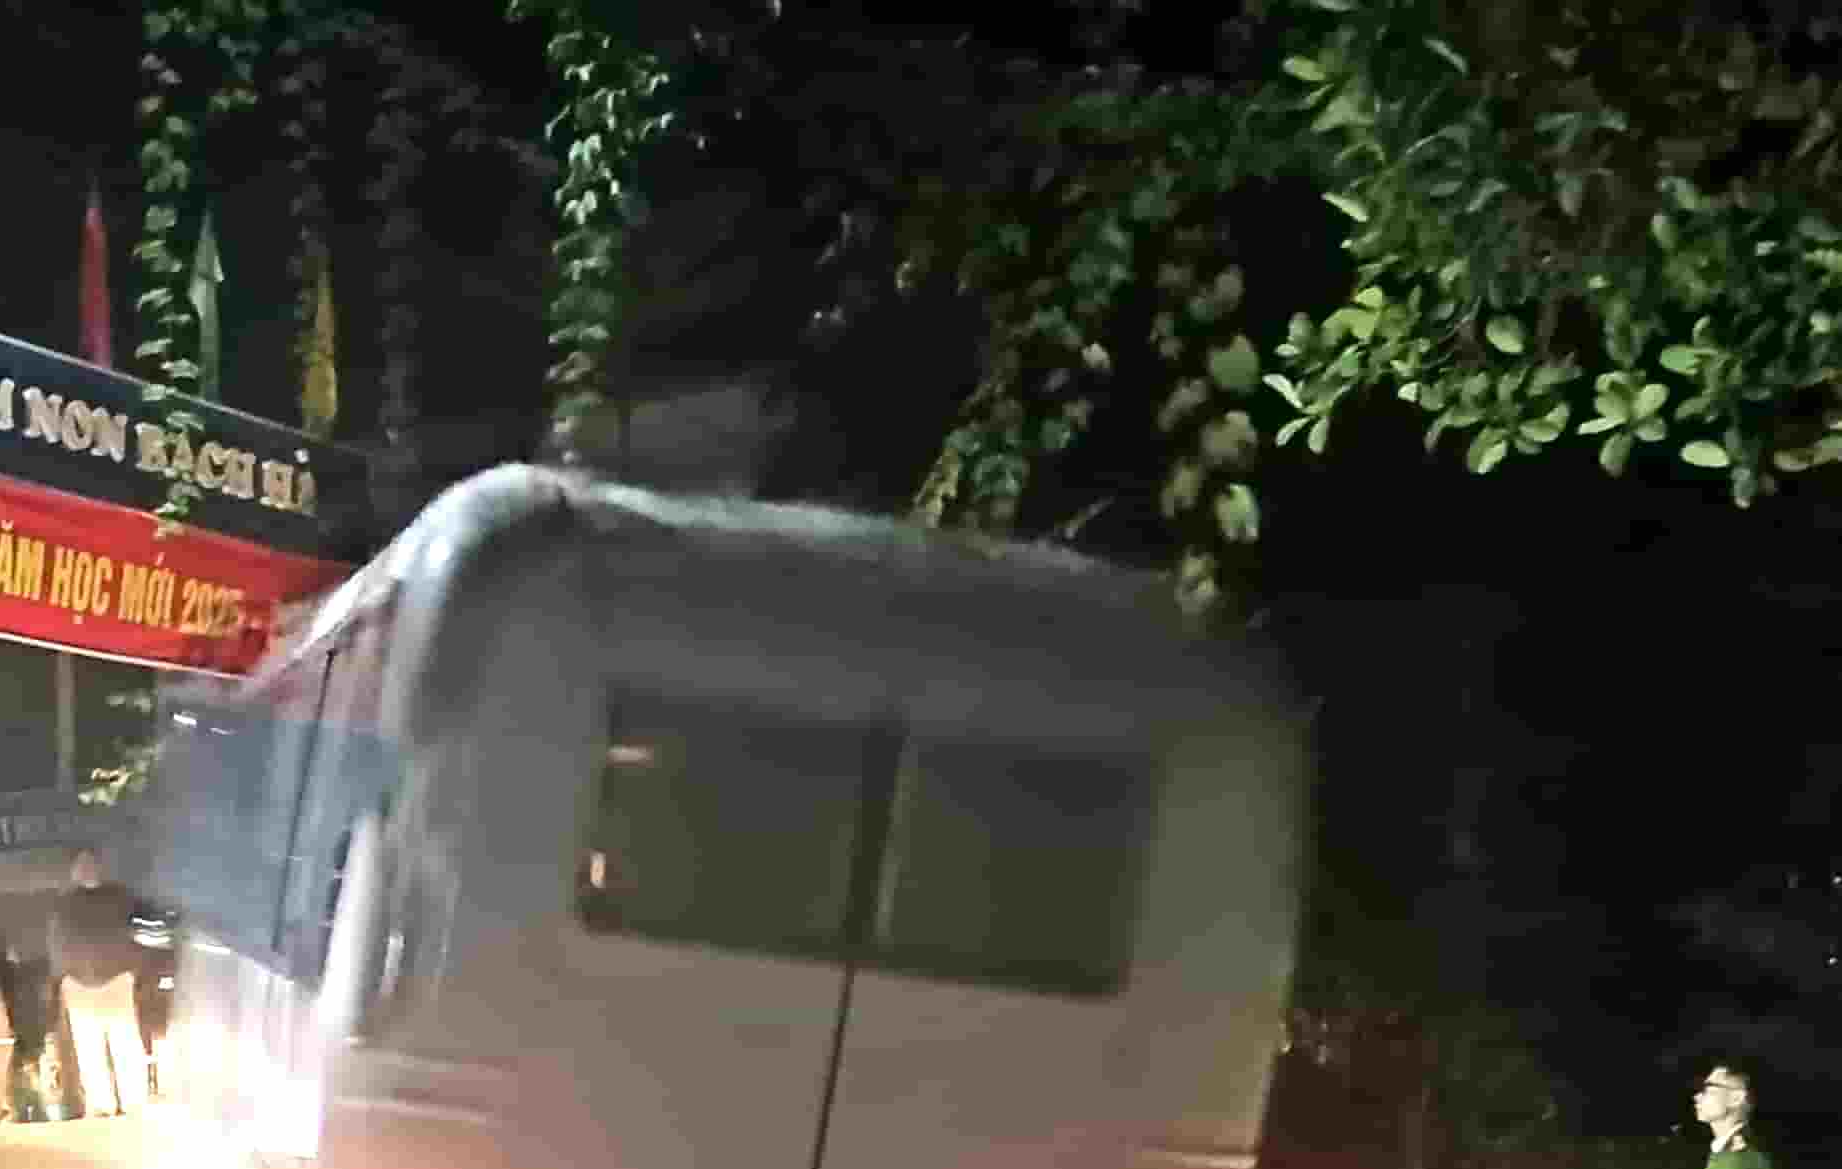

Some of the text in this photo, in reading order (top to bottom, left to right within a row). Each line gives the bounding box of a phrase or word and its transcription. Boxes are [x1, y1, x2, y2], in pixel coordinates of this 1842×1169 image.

[22, 386, 129, 463] NON
[50, 545, 112, 625] HỌC
[118, 552, 181, 629] MỚI
